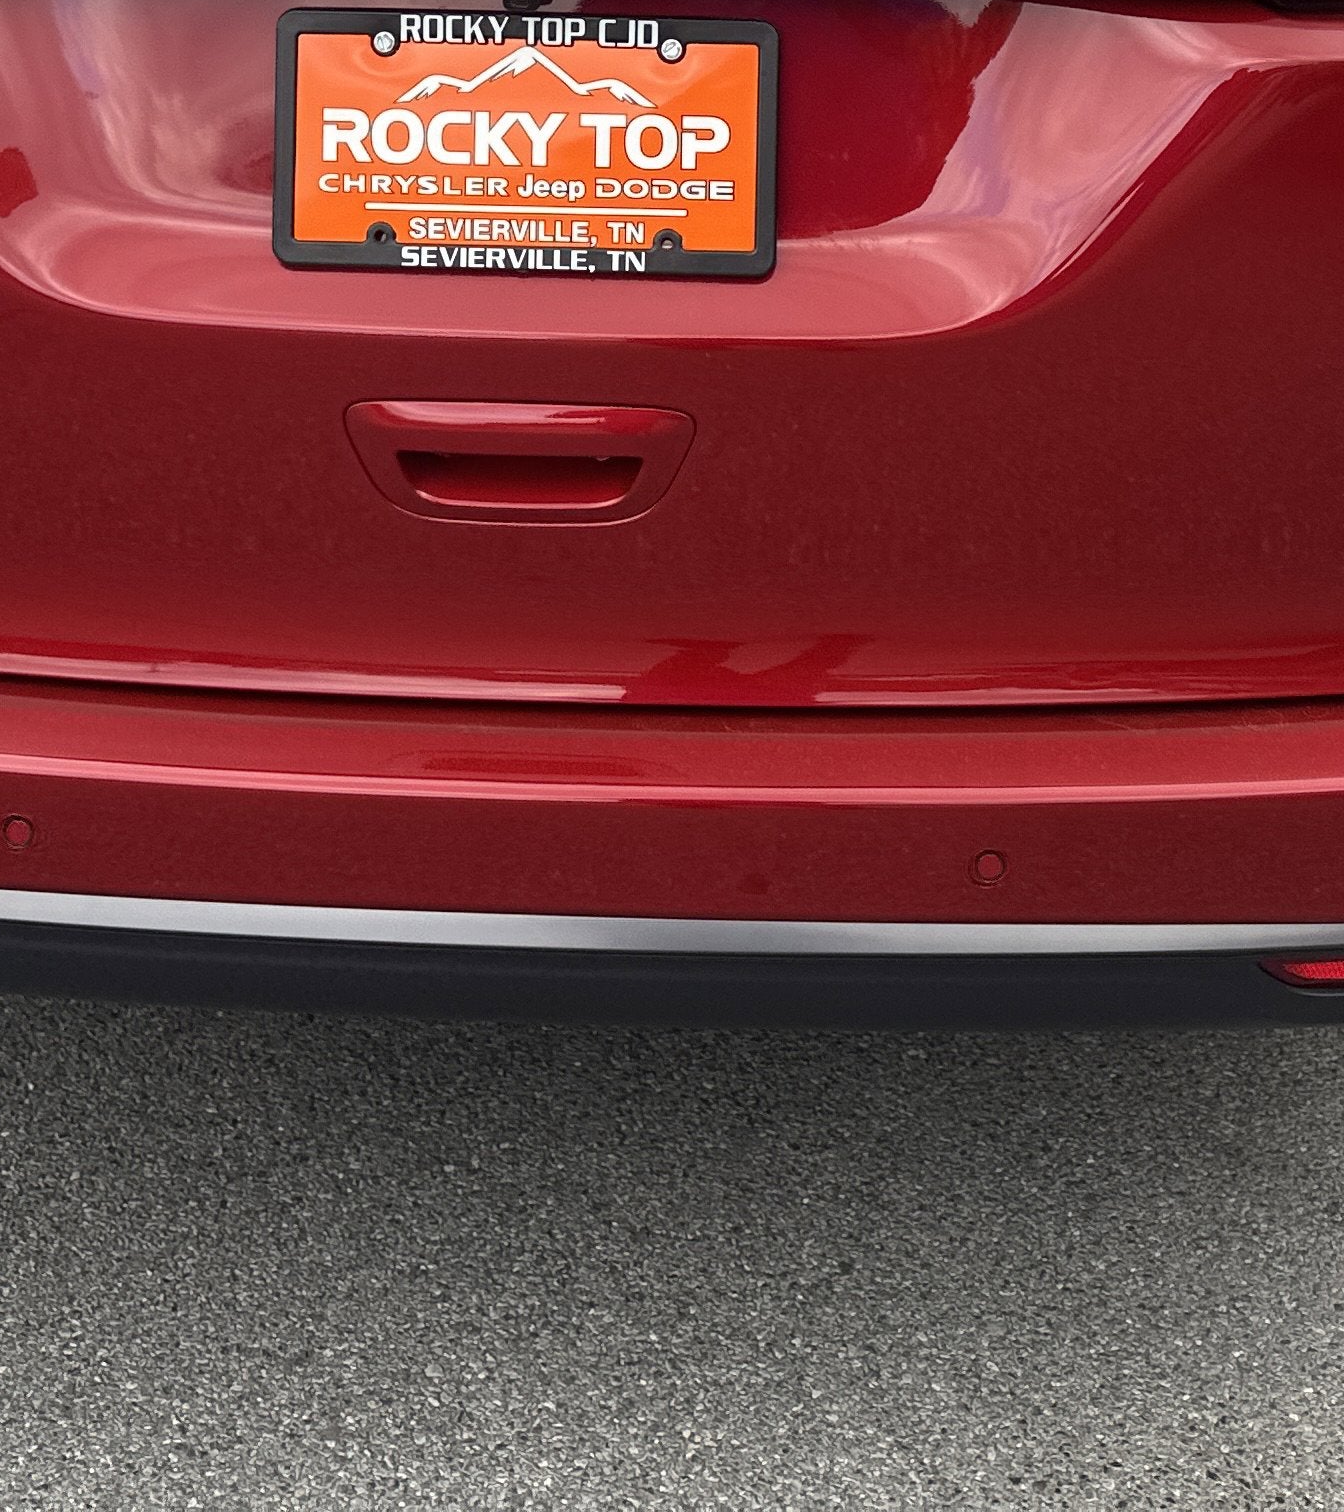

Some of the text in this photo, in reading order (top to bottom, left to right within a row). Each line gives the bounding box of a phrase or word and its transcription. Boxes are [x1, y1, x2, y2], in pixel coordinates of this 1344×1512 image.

[400, 13, 659, 49] ROCKY TOP CJD
[322, 107, 731, 171] ROCKY TOP
[318, 173, 735, 203] CHRYSLER Jeep DODGE
[408, 217, 645, 247] SEVIERVILLE, TN
[400, 246, 646, 273] SEVIERVILLE, TN
